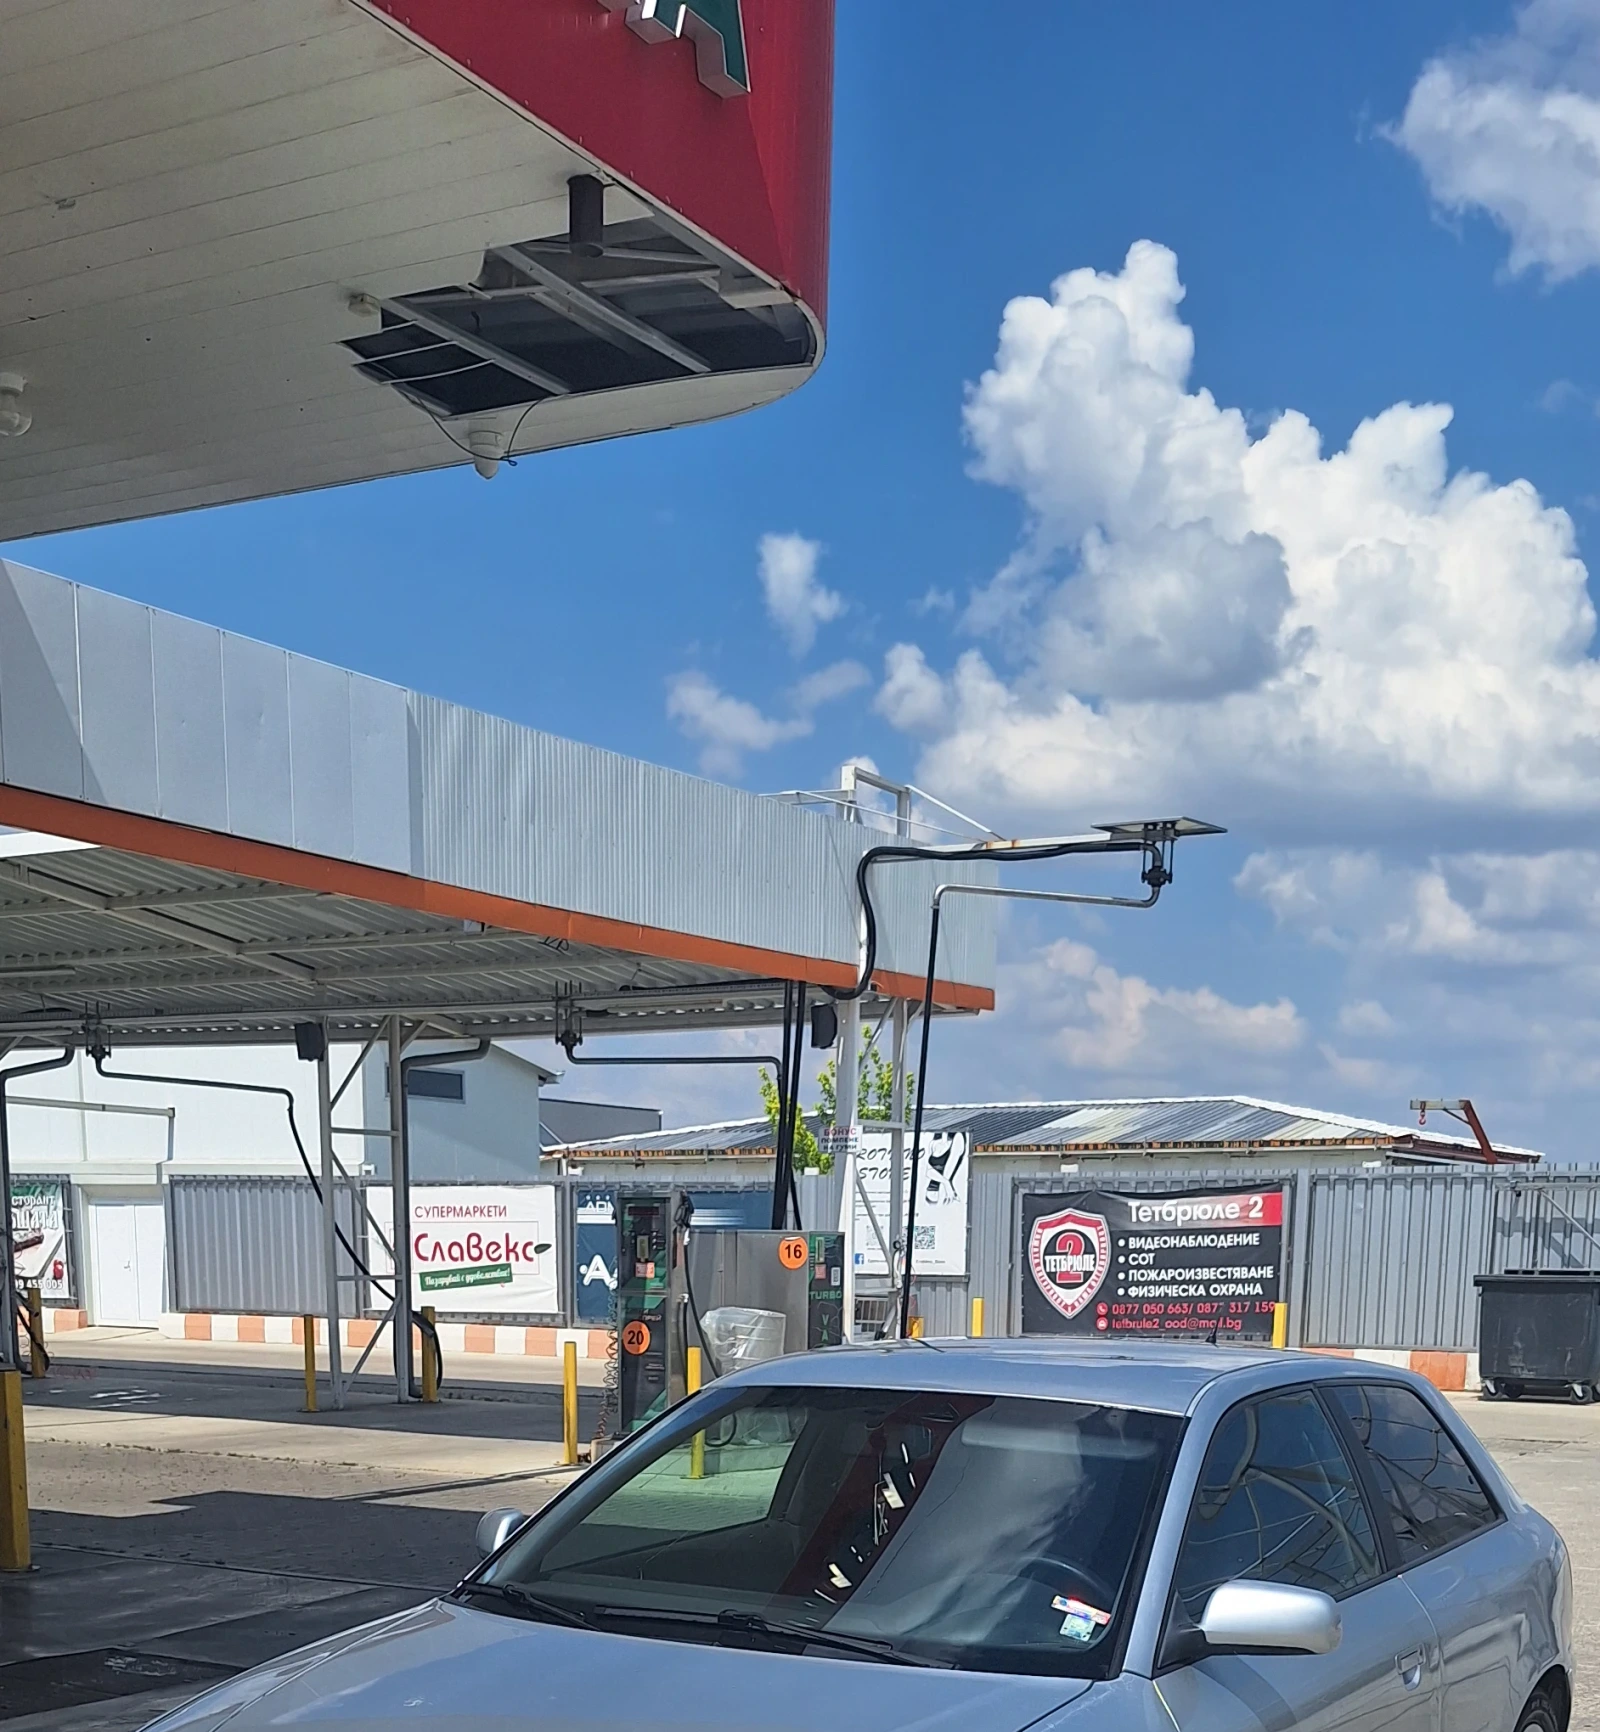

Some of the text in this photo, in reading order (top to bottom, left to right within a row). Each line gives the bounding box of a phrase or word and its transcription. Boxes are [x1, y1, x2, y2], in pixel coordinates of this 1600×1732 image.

[823, 1127, 857, 1136] БОНУС
[859, 1166, 911, 1181] STOE
[414, 1205, 508, 1218] СУПЕРМАРКЕТИ
[1127, 1195, 1264, 1227] Тетбрюле 2
[1128, 1233, 1260, 1250] ВИДЕОНАБЛЮДЕНИЕ
[784, 1244, 803, 1259] 16
[1128, 1252, 1156, 1266] СОТ
[1044, 1254, 1096, 1272] ТЕТБРЮЛЕ
[1128, 1265, 1274, 1282] ПОЖАРОИЗВЕСТЯВАНЕ
[809, 1290, 843, 1299] TURBO
[1127, 1283, 1264, 1298] ФИЗИЧЕСКА ОХРАНА
[1112, 1303, 1139, 1315] 0877
[1142, 1303, 1164, 1314] 050
[1167, 1302, 1194, 1315] 663/
[1229, 1301, 1250, 1313] 317
[1254, 1301, 1276, 1313] 159
[1112, 1317, 1242, 1332] tetbrule2_ood@mal.bg
[627, 1330, 644, 1345] 20
